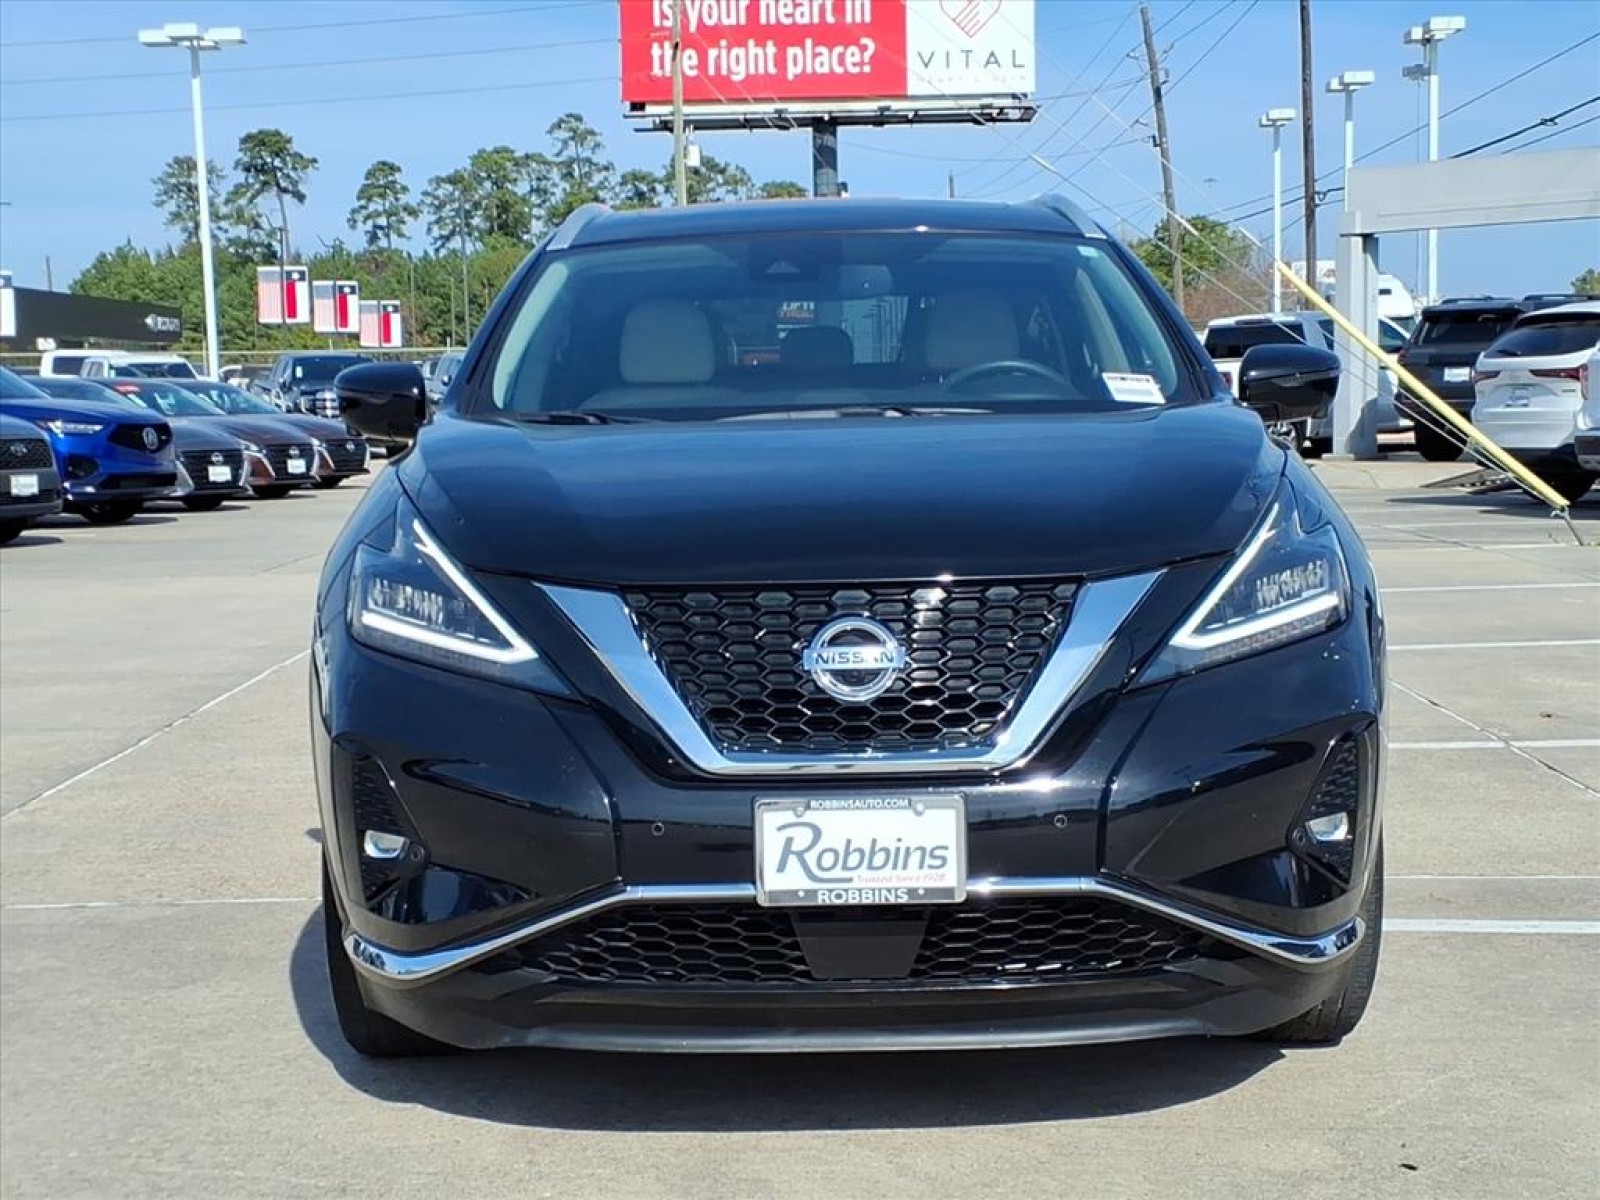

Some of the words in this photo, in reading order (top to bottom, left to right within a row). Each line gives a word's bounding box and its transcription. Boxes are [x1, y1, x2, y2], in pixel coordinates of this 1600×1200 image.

[652, 0, 673, 27] Is
[685, 0, 750, 33] your
[759, 0, 836, 25] heart
[845, 0, 872, 24] in
[651, 41, 699, 77] the
[706, 38, 777, 82] right
[786, 36, 875, 81] place?
[917, 49, 1025, 69] VITAL
[810, 799, 909, 810] ROBBINSAUTO.COM
[775, 821, 950, 884] Robbins
[817, 888, 909, 904] ROBBINS
